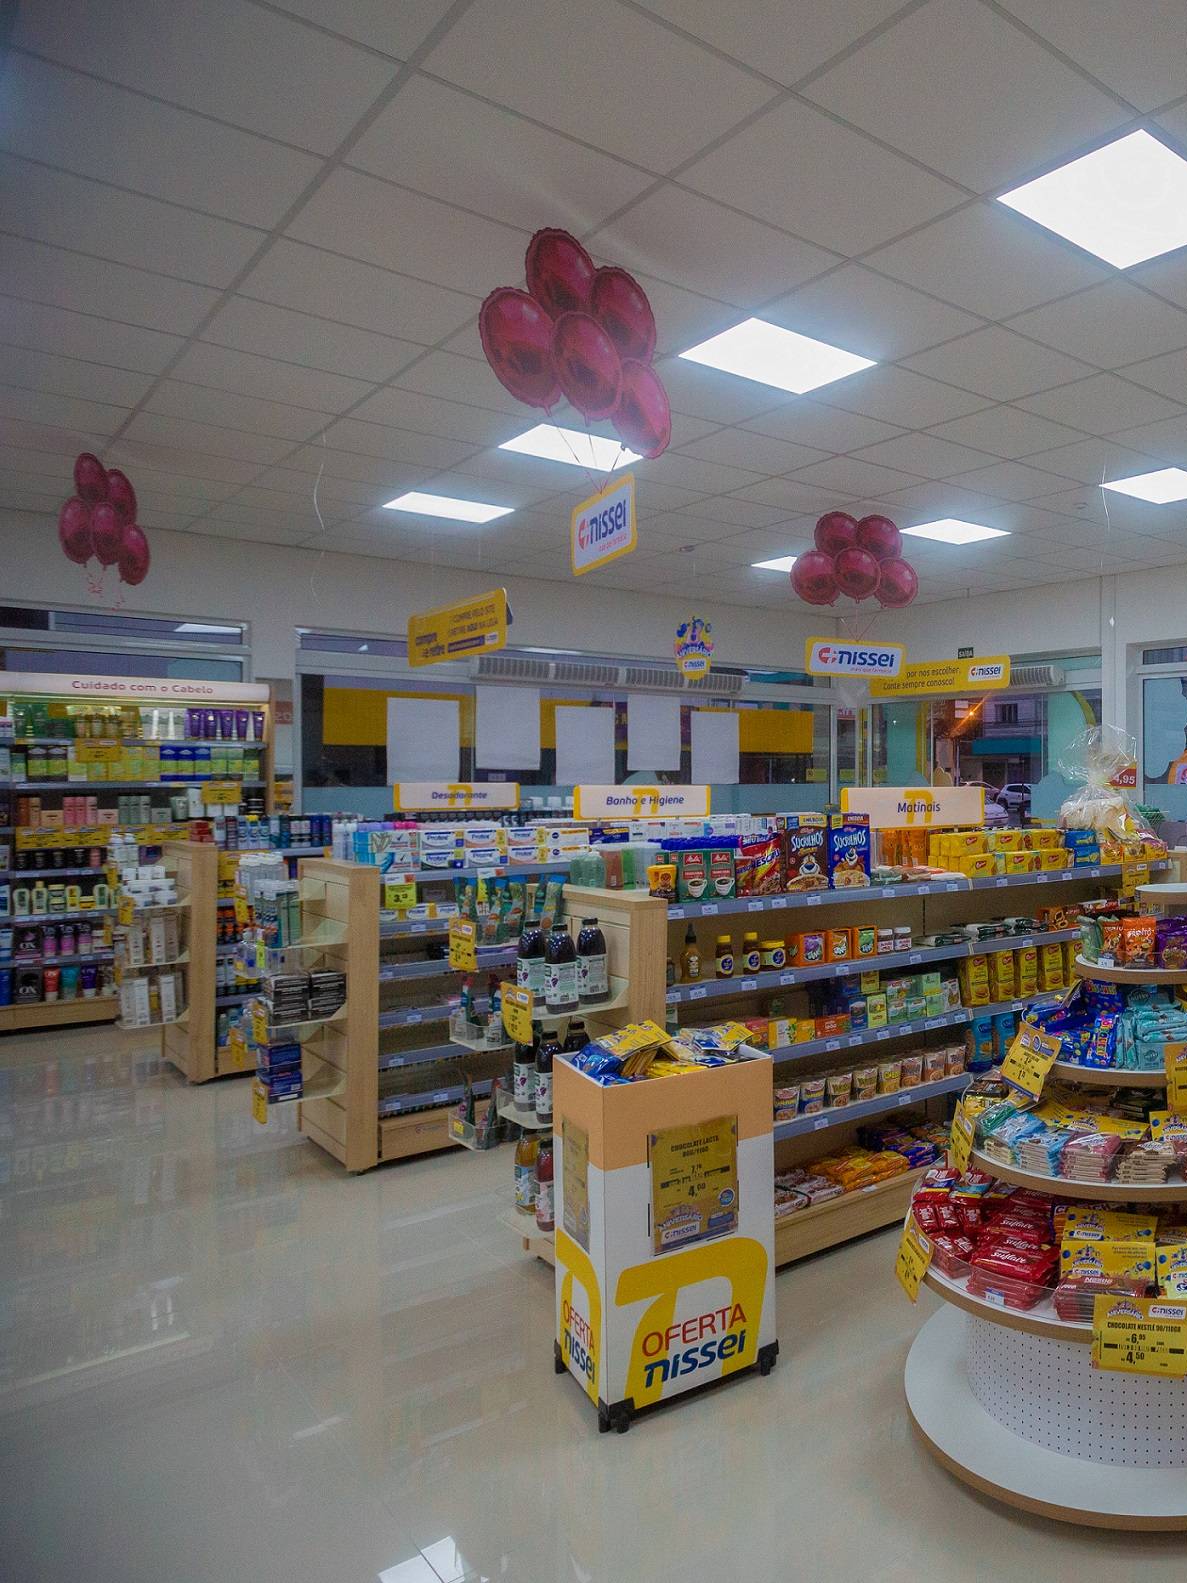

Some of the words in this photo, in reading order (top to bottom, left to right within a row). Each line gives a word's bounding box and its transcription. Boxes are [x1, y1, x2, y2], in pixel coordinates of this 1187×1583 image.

[838, 650, 894, 667] nissei
[978, 666, 1001, 676] nissei
[72, 680, 126, 691] Cuidado
[131, 684, 157, 692] com
[172, 684, 213, 695] Cabelo
[432, 791, 487, 800] Desodorante
[606, 796, 637, 805] Banho
[650, 795, 684, 806] Higiene
[897, 801, 940, 813] Matinais
[562, 1300, 594, 1356] OFERTA
[642, 1303, 747, 1357] OFERTA
[1107, 1322, 1136, 1330] CHOCOLATE
[564, 1328, 595, 1385] nissei
[644, 1329, 746, 1388] nissei
